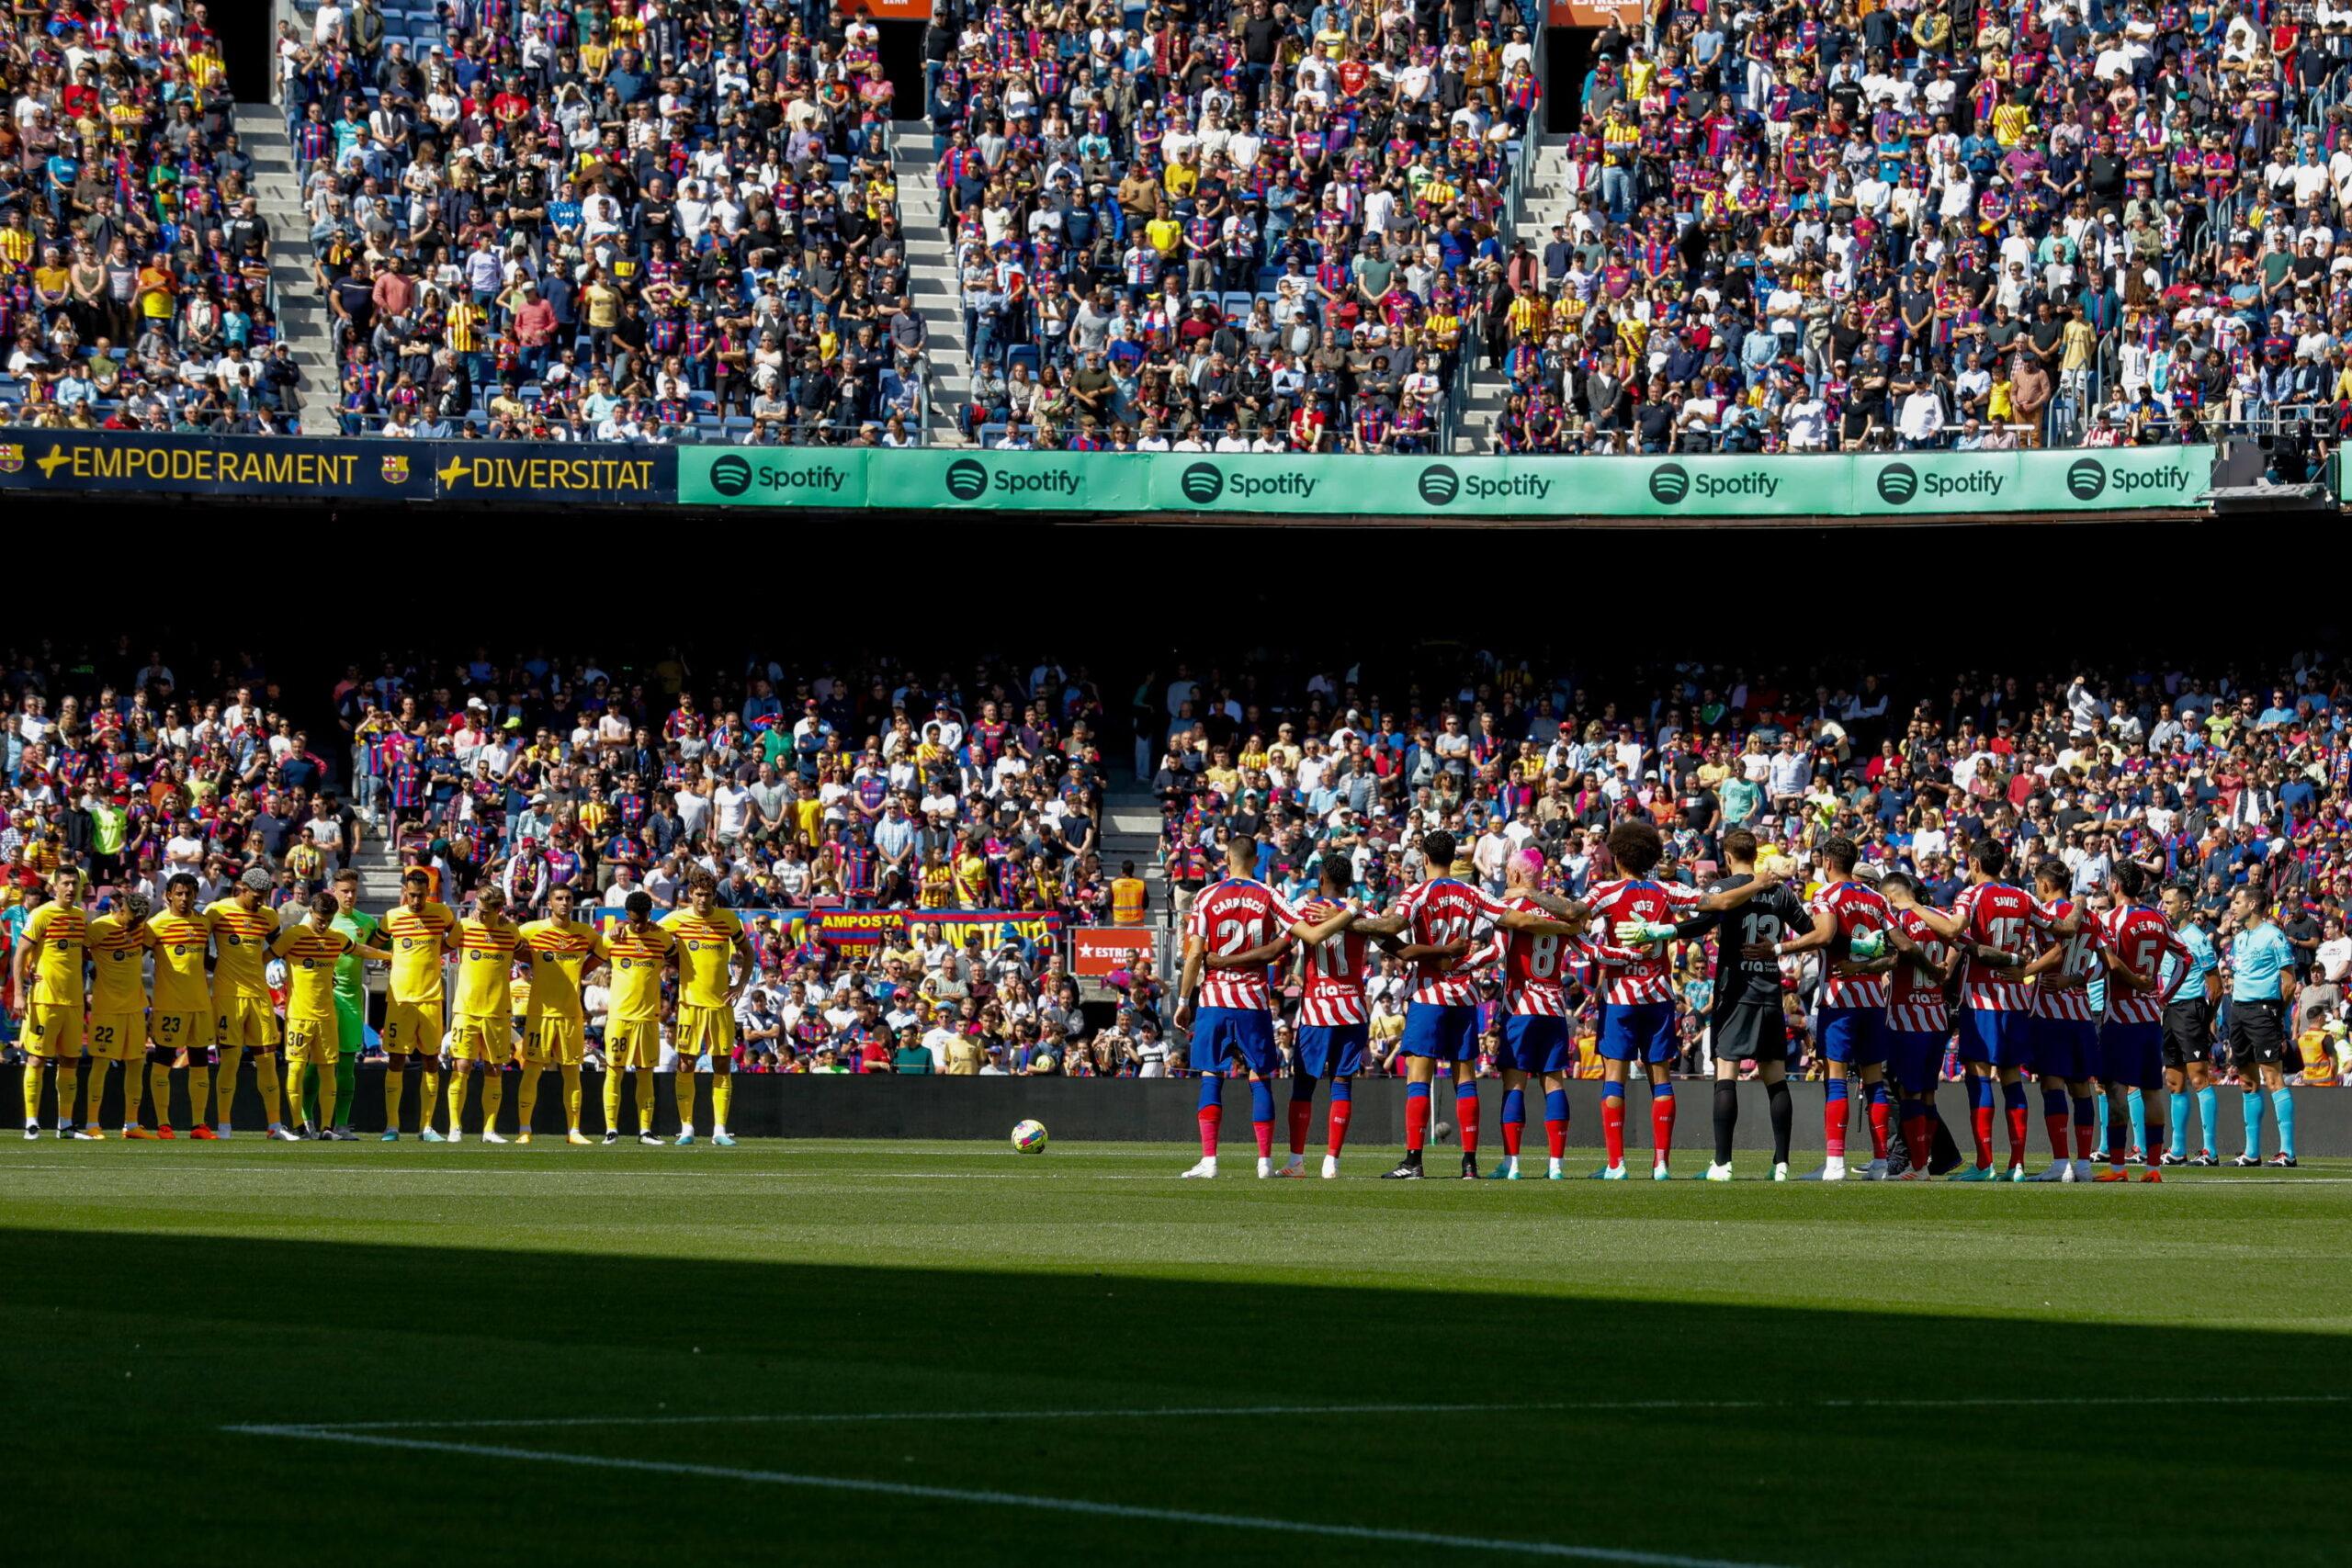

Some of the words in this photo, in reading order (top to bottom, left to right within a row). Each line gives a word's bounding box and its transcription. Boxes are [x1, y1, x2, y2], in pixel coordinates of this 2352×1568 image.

[758, 465, 845, 491] Spotify
[993, 468, 1080, 495] Spotify
[1229, 471, 1316, 498] Spotify
[1695, 471, 1780, 499] Spotify
[1923, 469, 2004, 496] Spotify
[2111, 465, 2190, 492] Spotify
[1464, 473, 1552, 501] Spotify
[822, 914, 904, 929] AMPOSTA
[910, 916, 1049, 950] CNSTANTÍ
[1217, 919, 1262, 956] 21
[1987, 917, 2025, 953] 15
[700, 942, 724, 952] Spotify
[840, 943, 871, 958] REU
[1095, 947, 1150, 958] ESTREA
[1316, 931, 1350, 979] 11
[1530, 933, 1558, 978] 8
[2061, 932, 2094, 976] 16
[2135, 940, 2157, 977] 5
[1624, 962, 1649, 976] ria
[1314, 981, 1338, 998] ria
[1908, 990, 1930, 1003] ria
[162, 1016, 181, 1033] 23
[219, 1015, 228, 1031] 4
[389, 1022, 398, 1039] 5
[36, 1024, 44, 1041] 9
[95, 1025, 114, 1043] 22
[288, 1031, 304, 1047] 30
[452, 1026, 464, 1043] 21
[528, 1032, 541, 1048] 11
[678, 1024, 692, 1040] 17
[611, 1036, 628, 1053] 28
